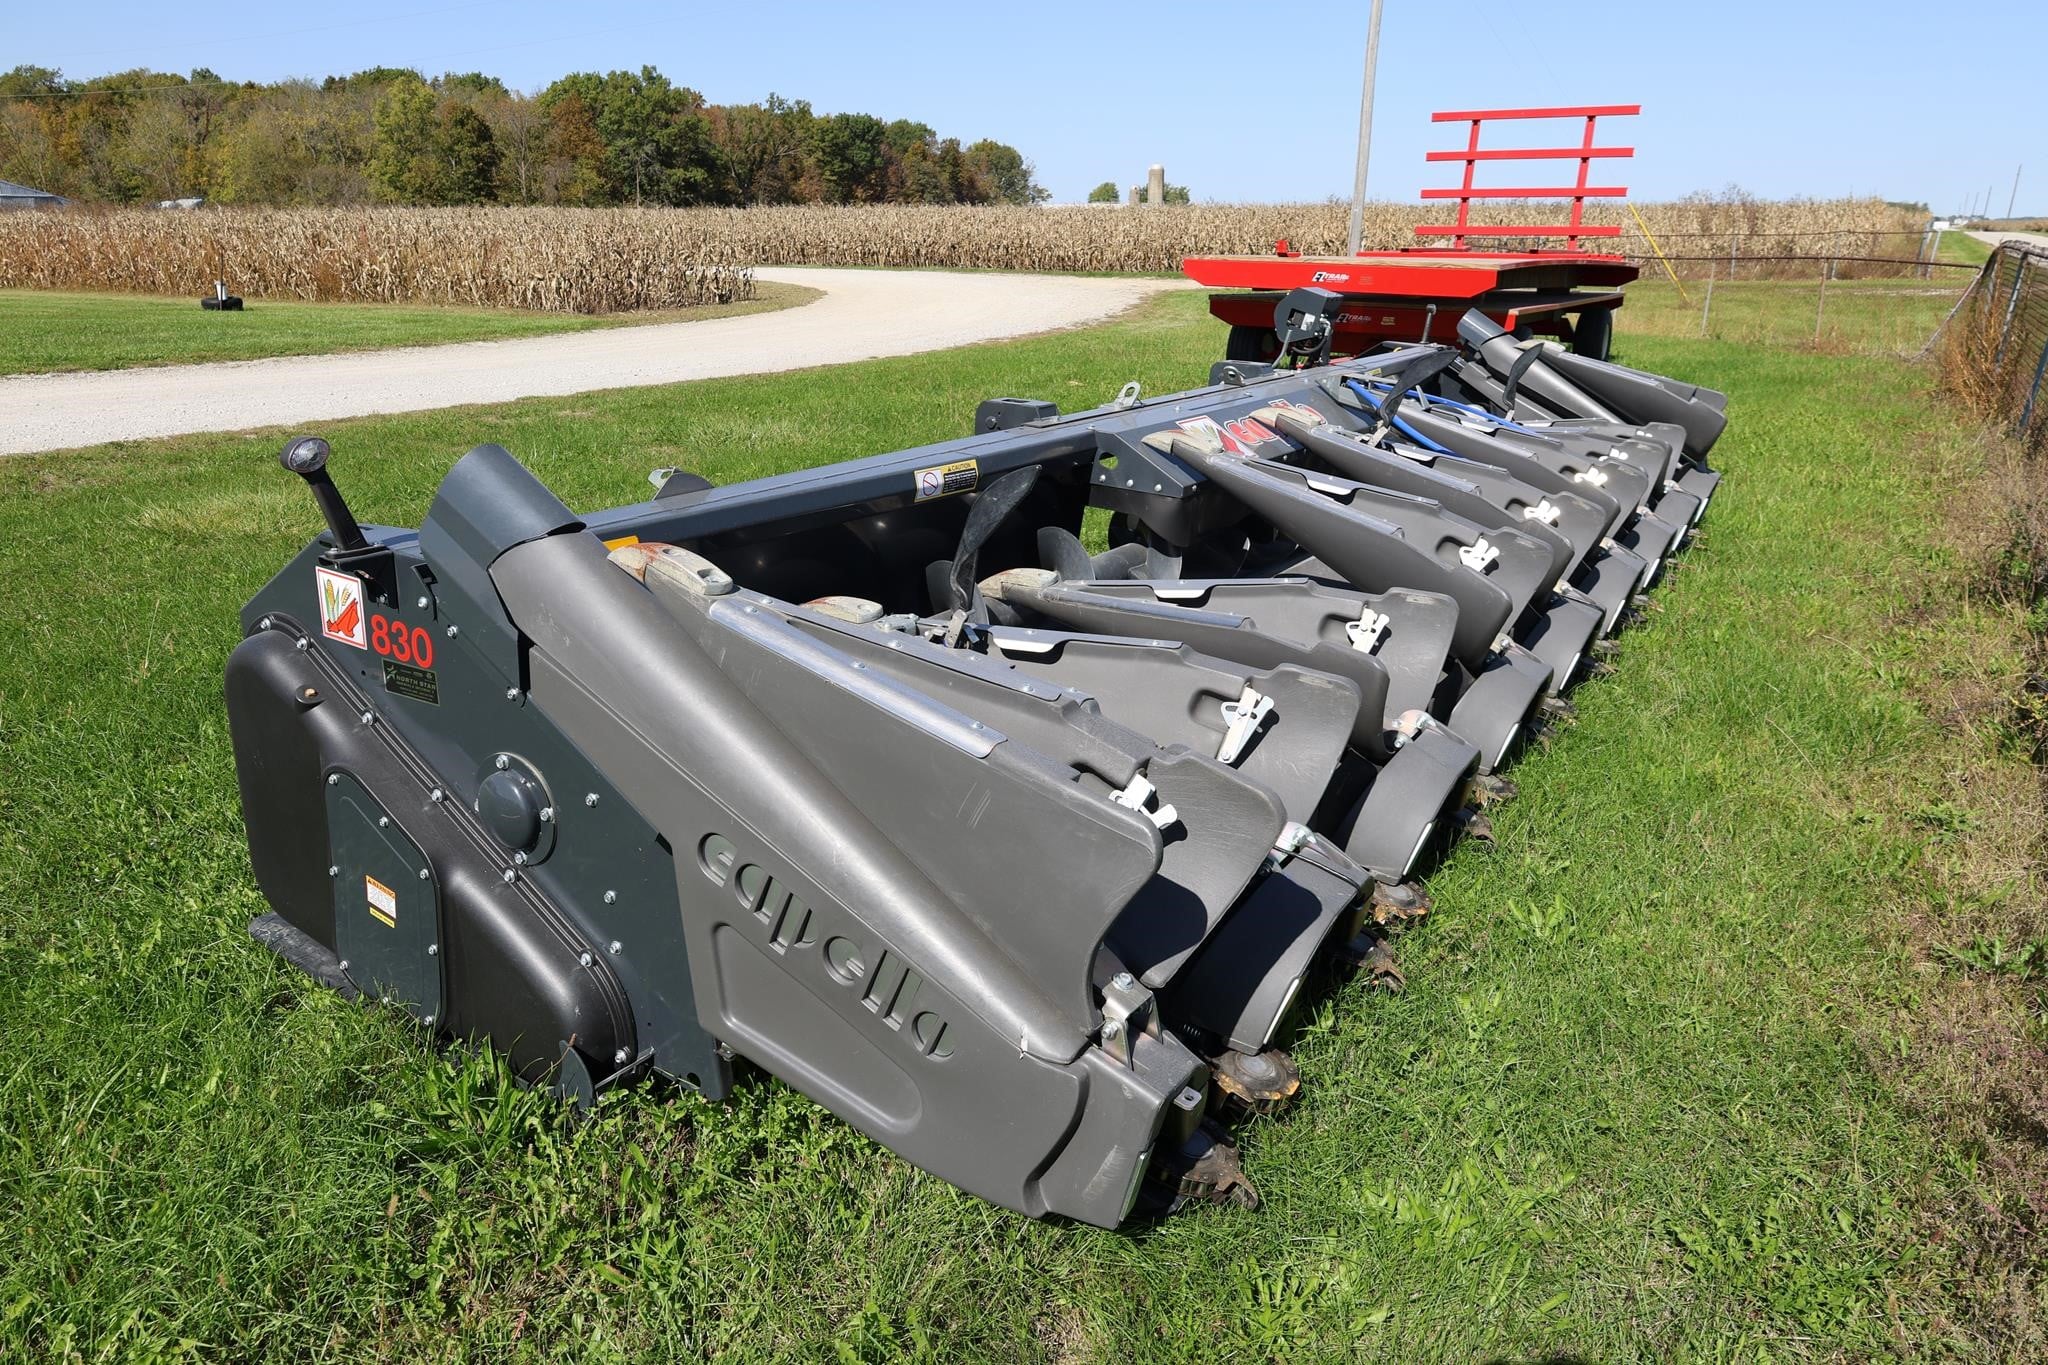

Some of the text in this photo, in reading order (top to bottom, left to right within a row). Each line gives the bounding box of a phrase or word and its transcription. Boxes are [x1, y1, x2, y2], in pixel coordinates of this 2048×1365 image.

[952, 462, 971, 471] CAUTION
[371, 614, 433, 668] 830
[396, 675, 436, 690] NORTH STAR
